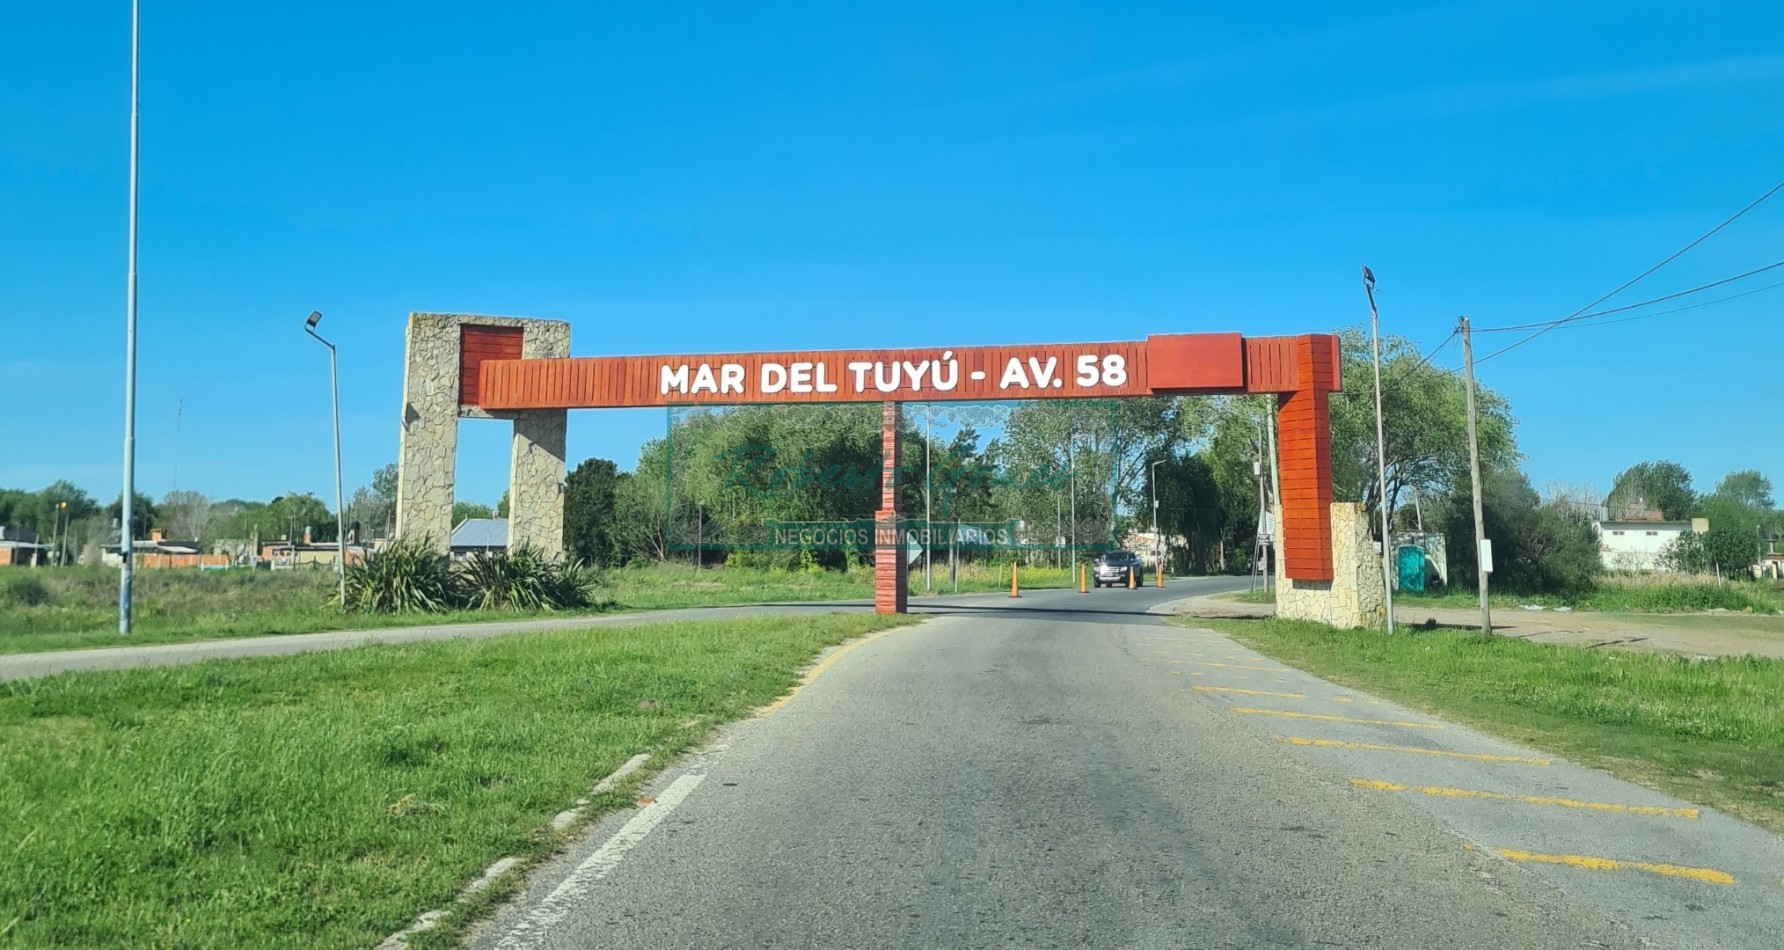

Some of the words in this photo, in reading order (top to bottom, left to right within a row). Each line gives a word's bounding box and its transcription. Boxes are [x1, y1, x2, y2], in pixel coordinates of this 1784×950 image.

[660, 363, 745, 395] MAR
[760, 361, 838, 394] DEL
[848, 350, 959, 394] TUYÚ
[970, 370, 986, 380] -
[999, 356, 1063, 390] AV.
[1076, 354, 1128, 388] 58
